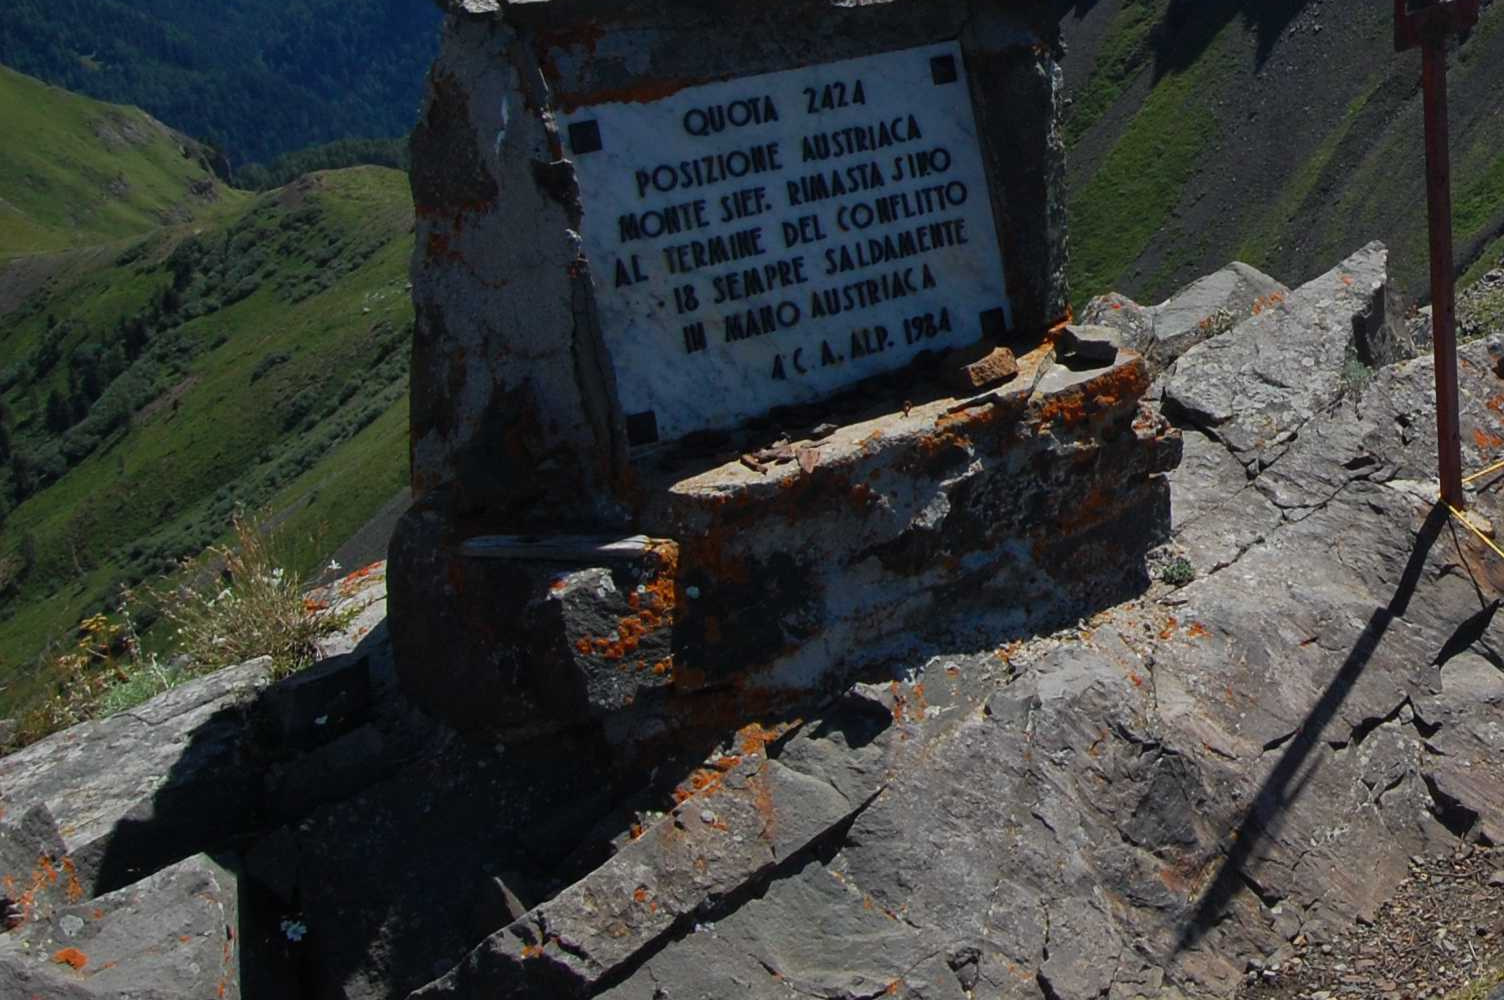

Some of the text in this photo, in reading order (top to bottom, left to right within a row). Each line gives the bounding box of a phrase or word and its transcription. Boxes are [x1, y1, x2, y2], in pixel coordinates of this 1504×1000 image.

[684, 80, 865, 136] QUOTA 2424
[618, 147, 951, 242] MONTE SIEF. RIMASTA SINO
[636, 115, 922, 198] POSIZIONE AUSTRIACA
[614, 181, 968, 288] AL TERMINE DEL CONFLITTO
[713, 256, 808, 304] SEMPRE
[825, 218, 968, 275] SALDAMENTE
[682, 264, 936, 354] IN MANO AUSTRIACA
[851, 326, 895, 359] ALP.
[903, 307, 952, 345] 1984
